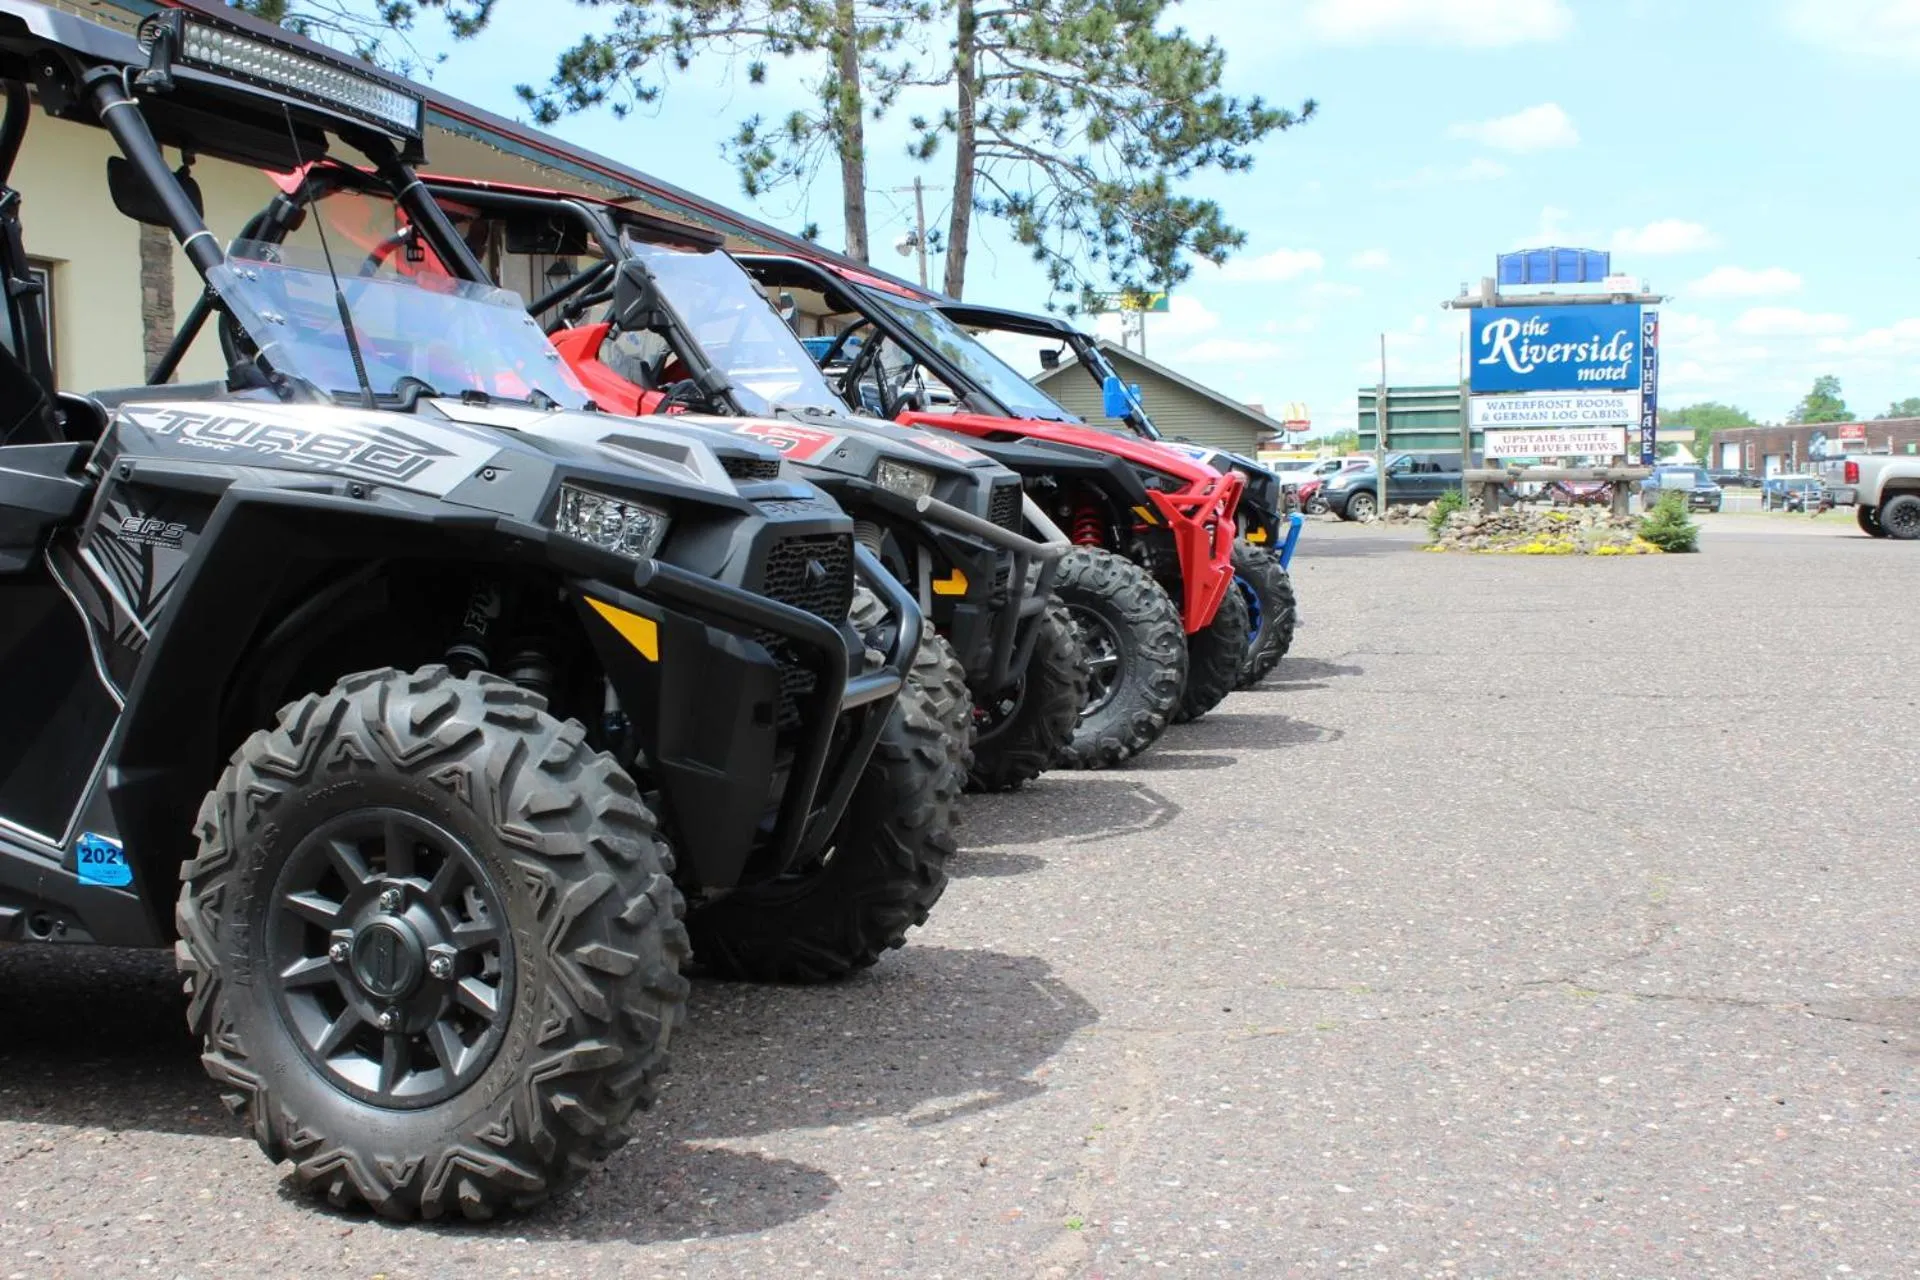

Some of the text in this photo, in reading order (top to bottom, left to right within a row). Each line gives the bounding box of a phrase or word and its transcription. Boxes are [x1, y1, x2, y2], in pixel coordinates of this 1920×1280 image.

[1522, 315, 1549, 336] the
[1478, 317, 1634, 374] Riverside
[1577, 360, 1632, 381] motel
[1642, 322, 1655, 454] ON THE LAKE
[1481, 408, 1629, 422] & GERMAN LOG CABINS
[1486, 398, 1624, 411] WATERFRONT ROOMS
[1493, 442, 1619, 454] WITH RIVER VIEWS
[1503, 432, 1609, 444] UPSTAIRS SUITE
[121, 516, 187, 539] EPS
